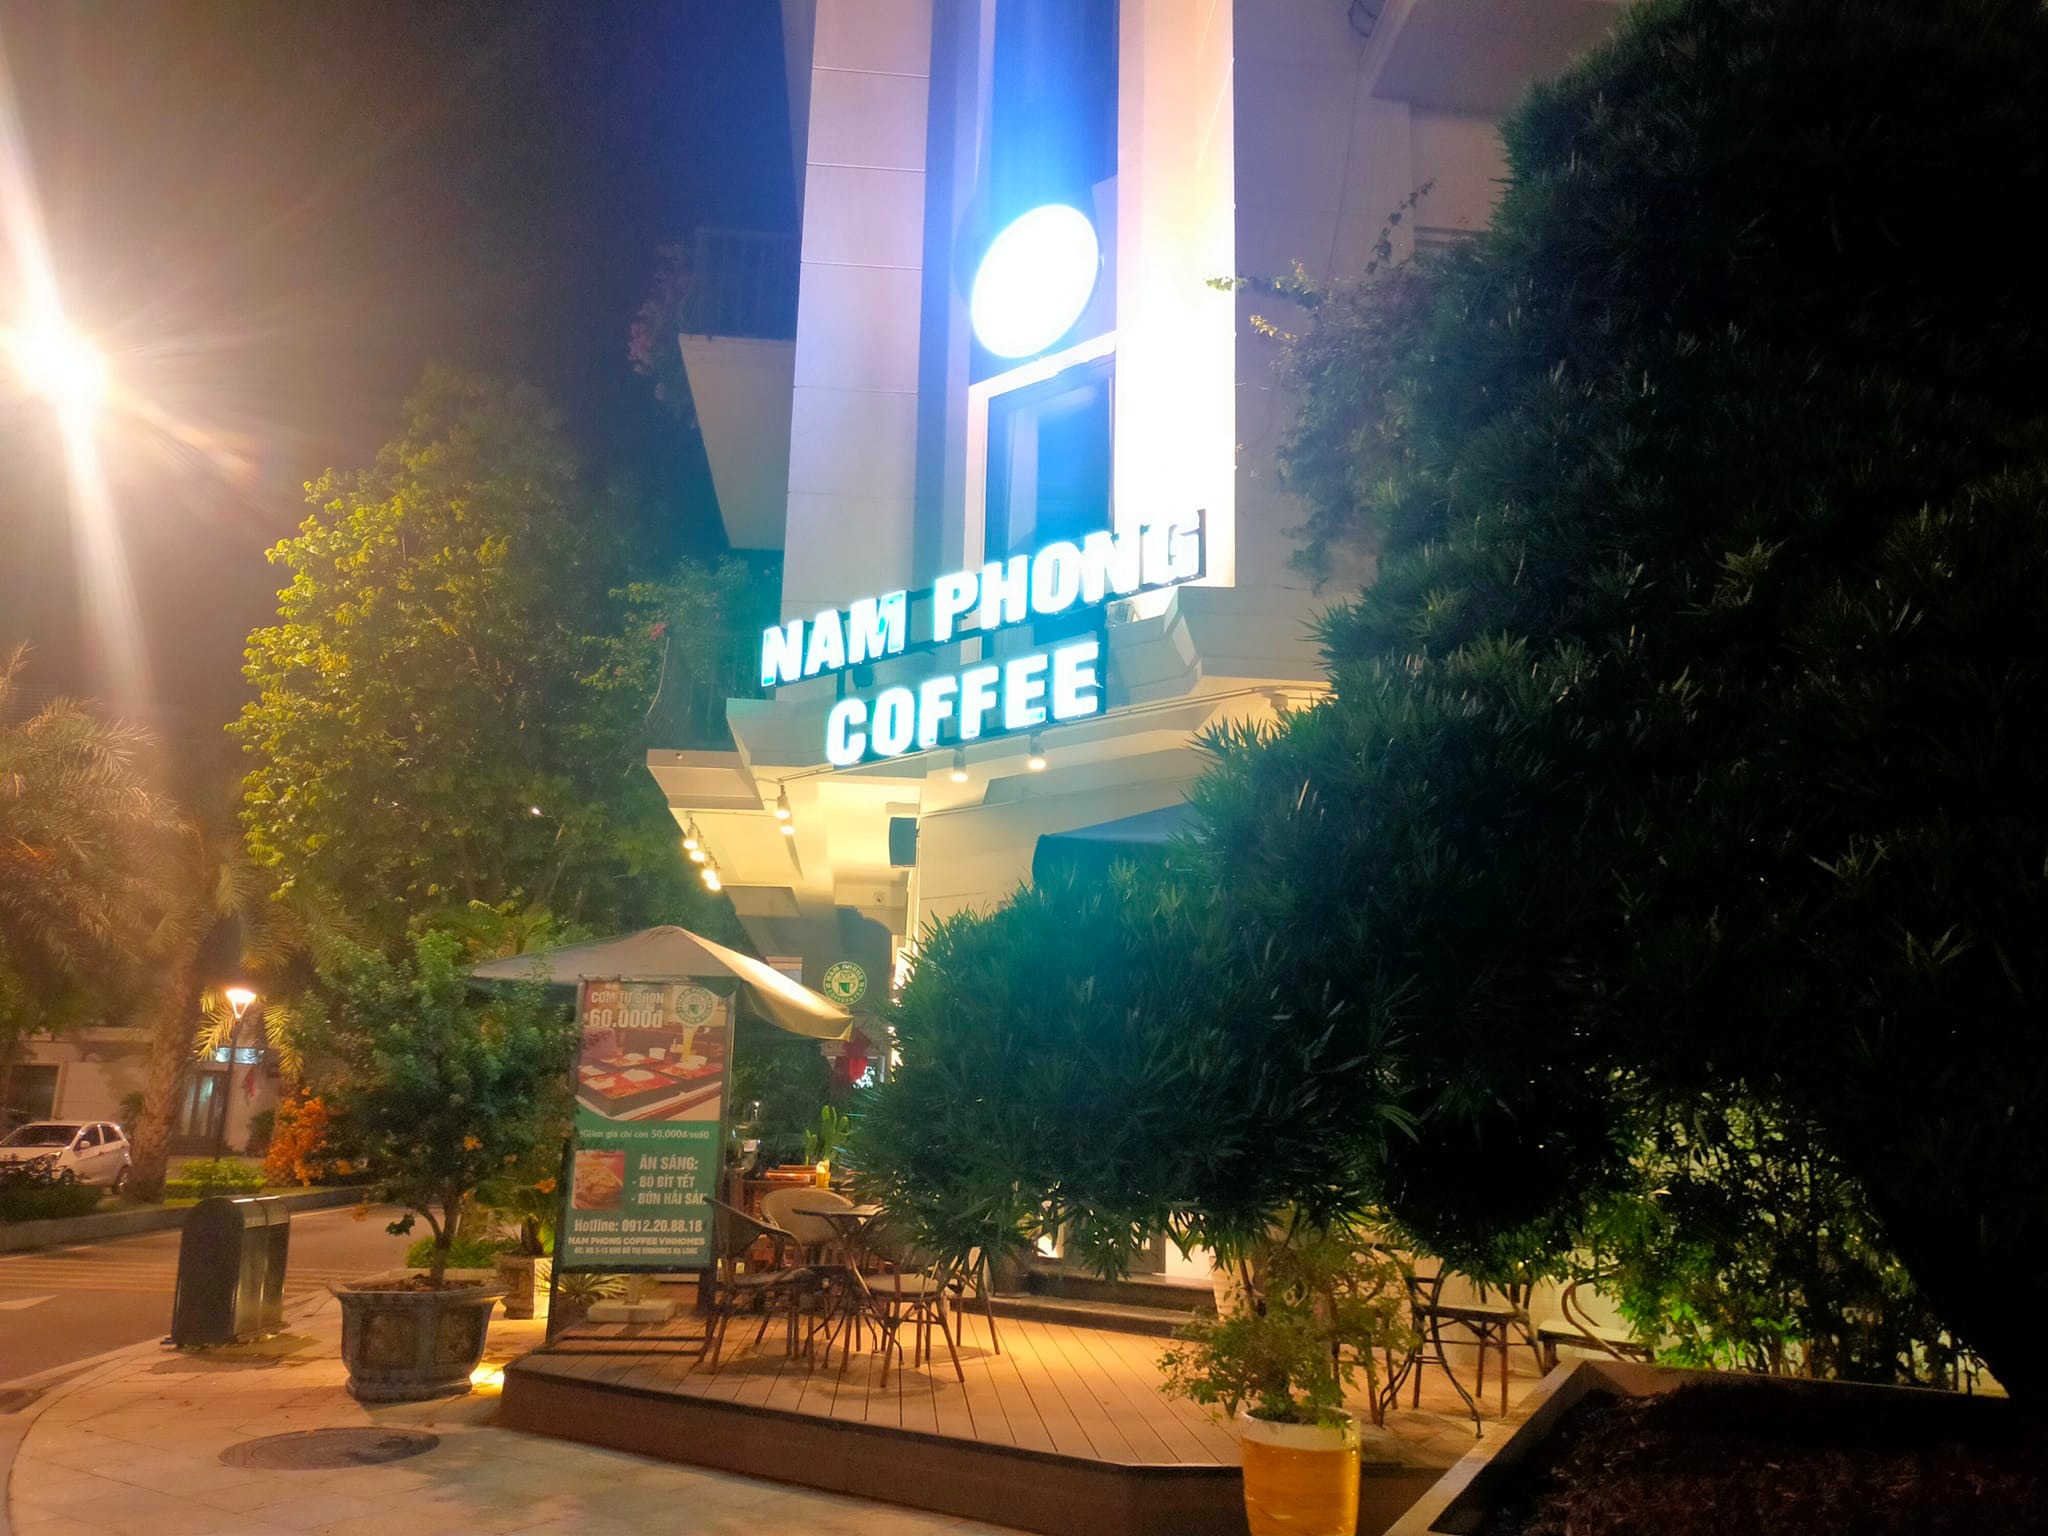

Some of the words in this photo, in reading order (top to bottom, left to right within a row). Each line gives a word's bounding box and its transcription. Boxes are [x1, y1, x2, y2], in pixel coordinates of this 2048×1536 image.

[761, 590, 907, 687] NAM
[932, 509, 1206, 642] PHONG
[825, 641, 1101, 766] COFFEE
[639, 1153, 657, 1170] ĂN
[660, 1153, 699, 1170] SÁNG:
[676, 1172, 696, 1188] TẾT
[638, 1190, 661, 1205] BÚN
[574, 1218, 619, 1232] Hotline:
[568, 1237, 590, 1246] NAM
[590, 1237, 622, 1246] PHONG
[623, 1237, 658, 1246] COFFEE
